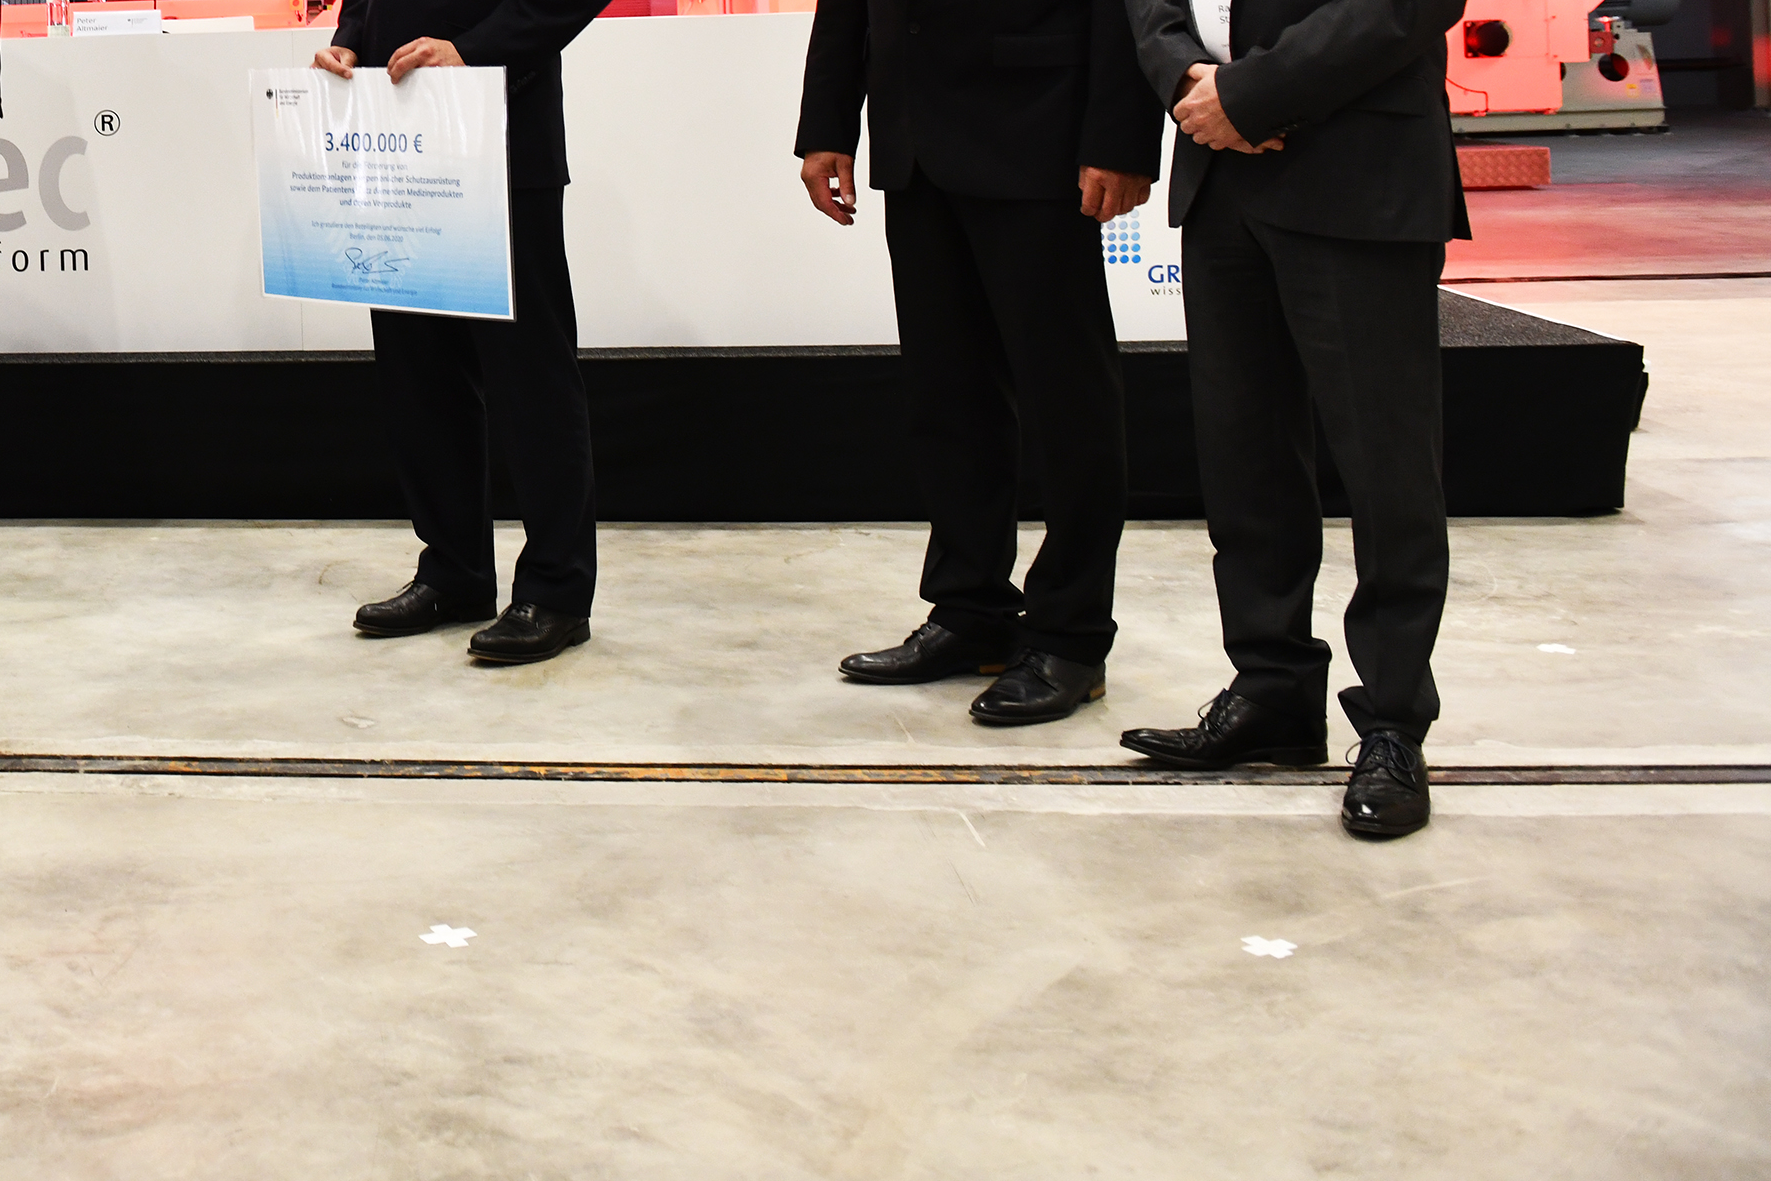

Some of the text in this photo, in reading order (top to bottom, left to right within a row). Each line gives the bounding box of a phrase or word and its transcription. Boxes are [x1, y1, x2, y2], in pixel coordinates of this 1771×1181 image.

[325, 132, 423, 154] 3.400.000 €
[405, 175, 461, 187] Schutzausrüstung
[407, 188, 464, 199] Medizinprodukten
[1150, 286, 1181, 296] wiss
